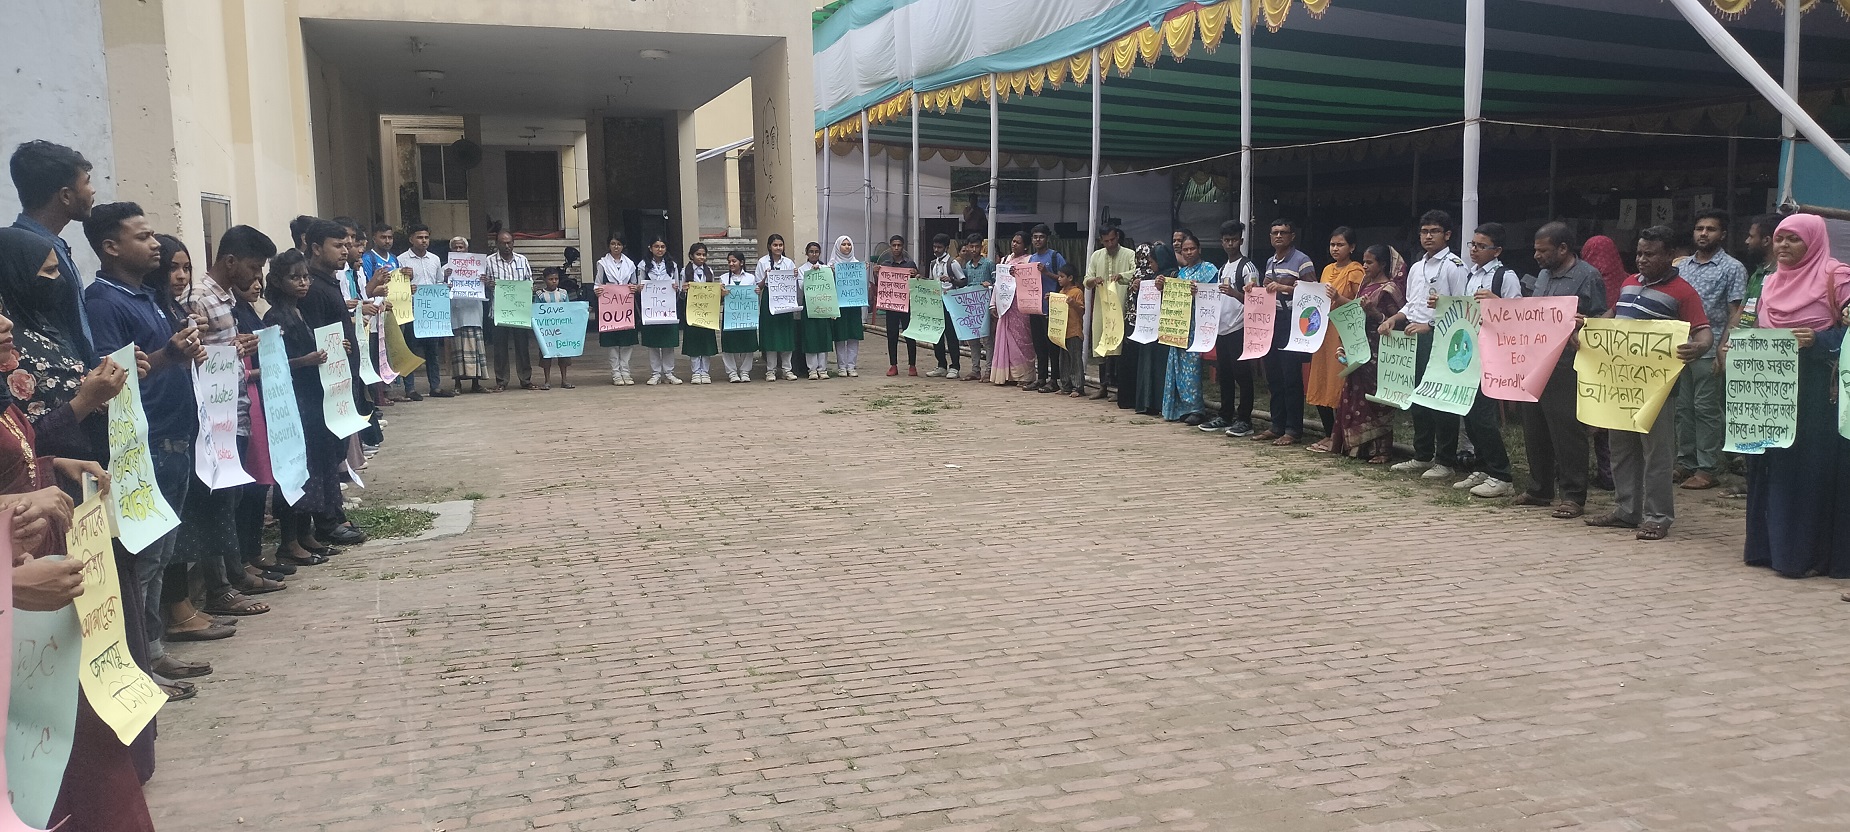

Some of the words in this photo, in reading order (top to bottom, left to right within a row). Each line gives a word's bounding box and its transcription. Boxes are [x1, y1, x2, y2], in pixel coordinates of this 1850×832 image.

[837, 279, 860, 287] CRISIS
[601, 291, 634, 306] SAVE
[729, 288, 752, 300] SAFE
[416, 299, 432, 308] THE
[538, 304, 564, 315] Save
[728, 301, 758, 311] CLIMATE
[602, 309, 633, 323] OUR
[731, 312, 752, 321] SAFE
[1487, 307, 1511, 323] We
[1514, 307, 1545, 321] Want
[1550, 307, 1563, 323] To
[1380, 335, 1416, 353] CLIMATE
[1496, 332, 1517, 347] Live
[1533, 333, 1547, 345] An
[1583, 327, 1674, 360] আপনার
[205, 351, 220, 376] We
[1380, 351, 1412, 369] JUSTICE
[1511, 351, 1526, 365] Eco
[1597, 355, 1671, 384] পরিবেশ
[1383, 369, 1415, 390] HUMAN
[209, 383, 235, 404] Justice
[1415, 380, 1442, 399] OUR
[1438, 383, 1478, 407] PLANET
[1577, 380, 1645, 404] আপনার
[269, 400, 291, 423] Food
[269, 421, 301, 447] Security
